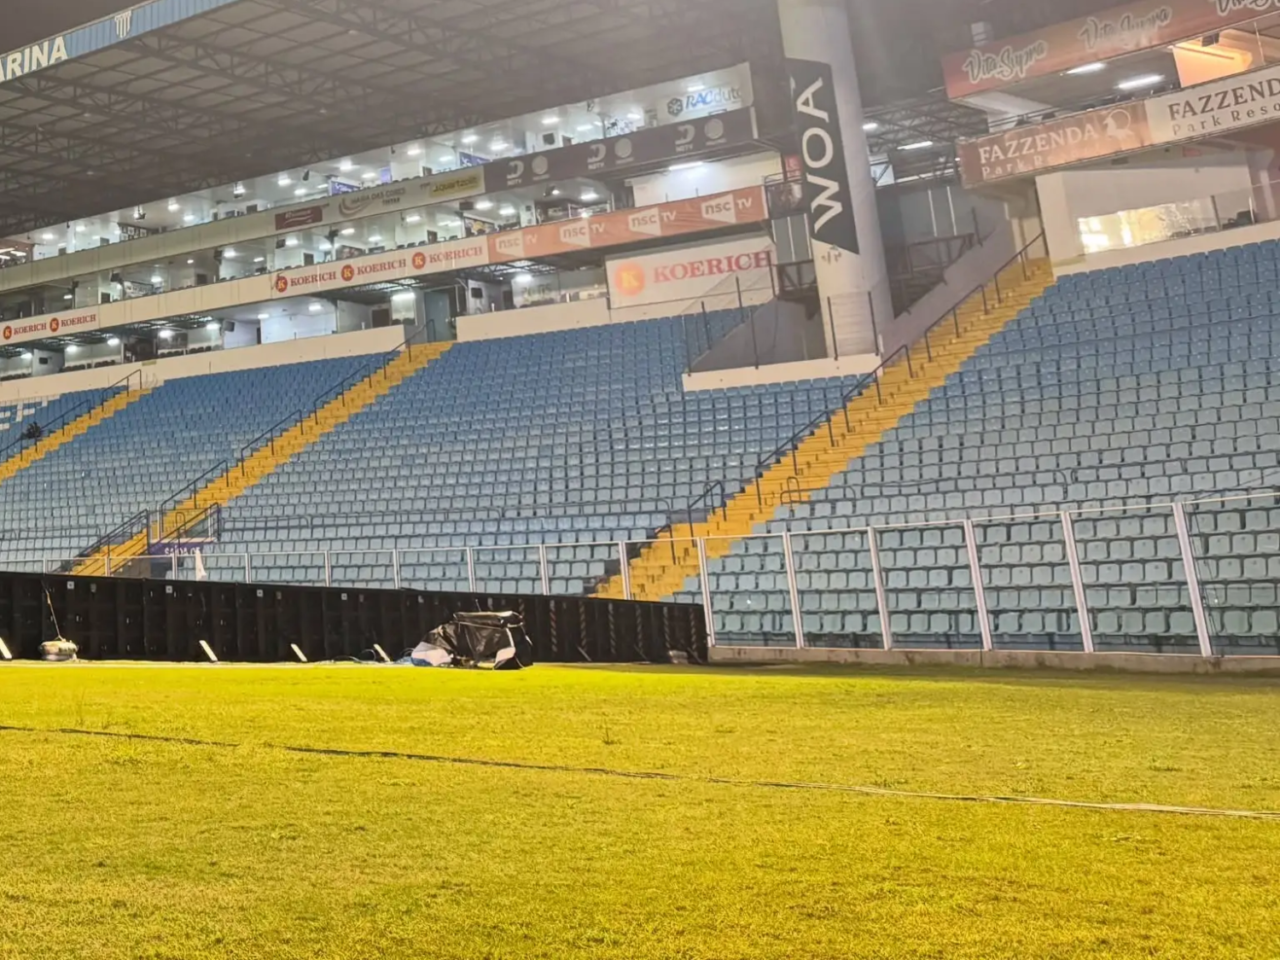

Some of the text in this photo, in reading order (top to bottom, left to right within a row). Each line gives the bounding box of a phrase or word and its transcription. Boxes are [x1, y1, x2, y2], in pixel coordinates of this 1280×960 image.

[963, 50, 998, 82] Vita
[1172, 114, 1223, 136] Park
[797, 76, 843, 234] WOA
[979, 123, 1098, 165] FAZZENDA
[704, 197, 752, 215] nsc TV
[631, 210, 677, 228] nsc TV
[563, 223, 605, 239] nsc TV
[498, 238, 520, 250] nsc
[290, 271, 336, 287] KOERICH
[357, 258, 406, 275] KOERICH
[429, 246, 483, 264] KOERICH
[654, 250, 771, 284] KOERICH
[13, 322, 47, 336] KOERICH
[61, 314, 97, 327] KOERICH
